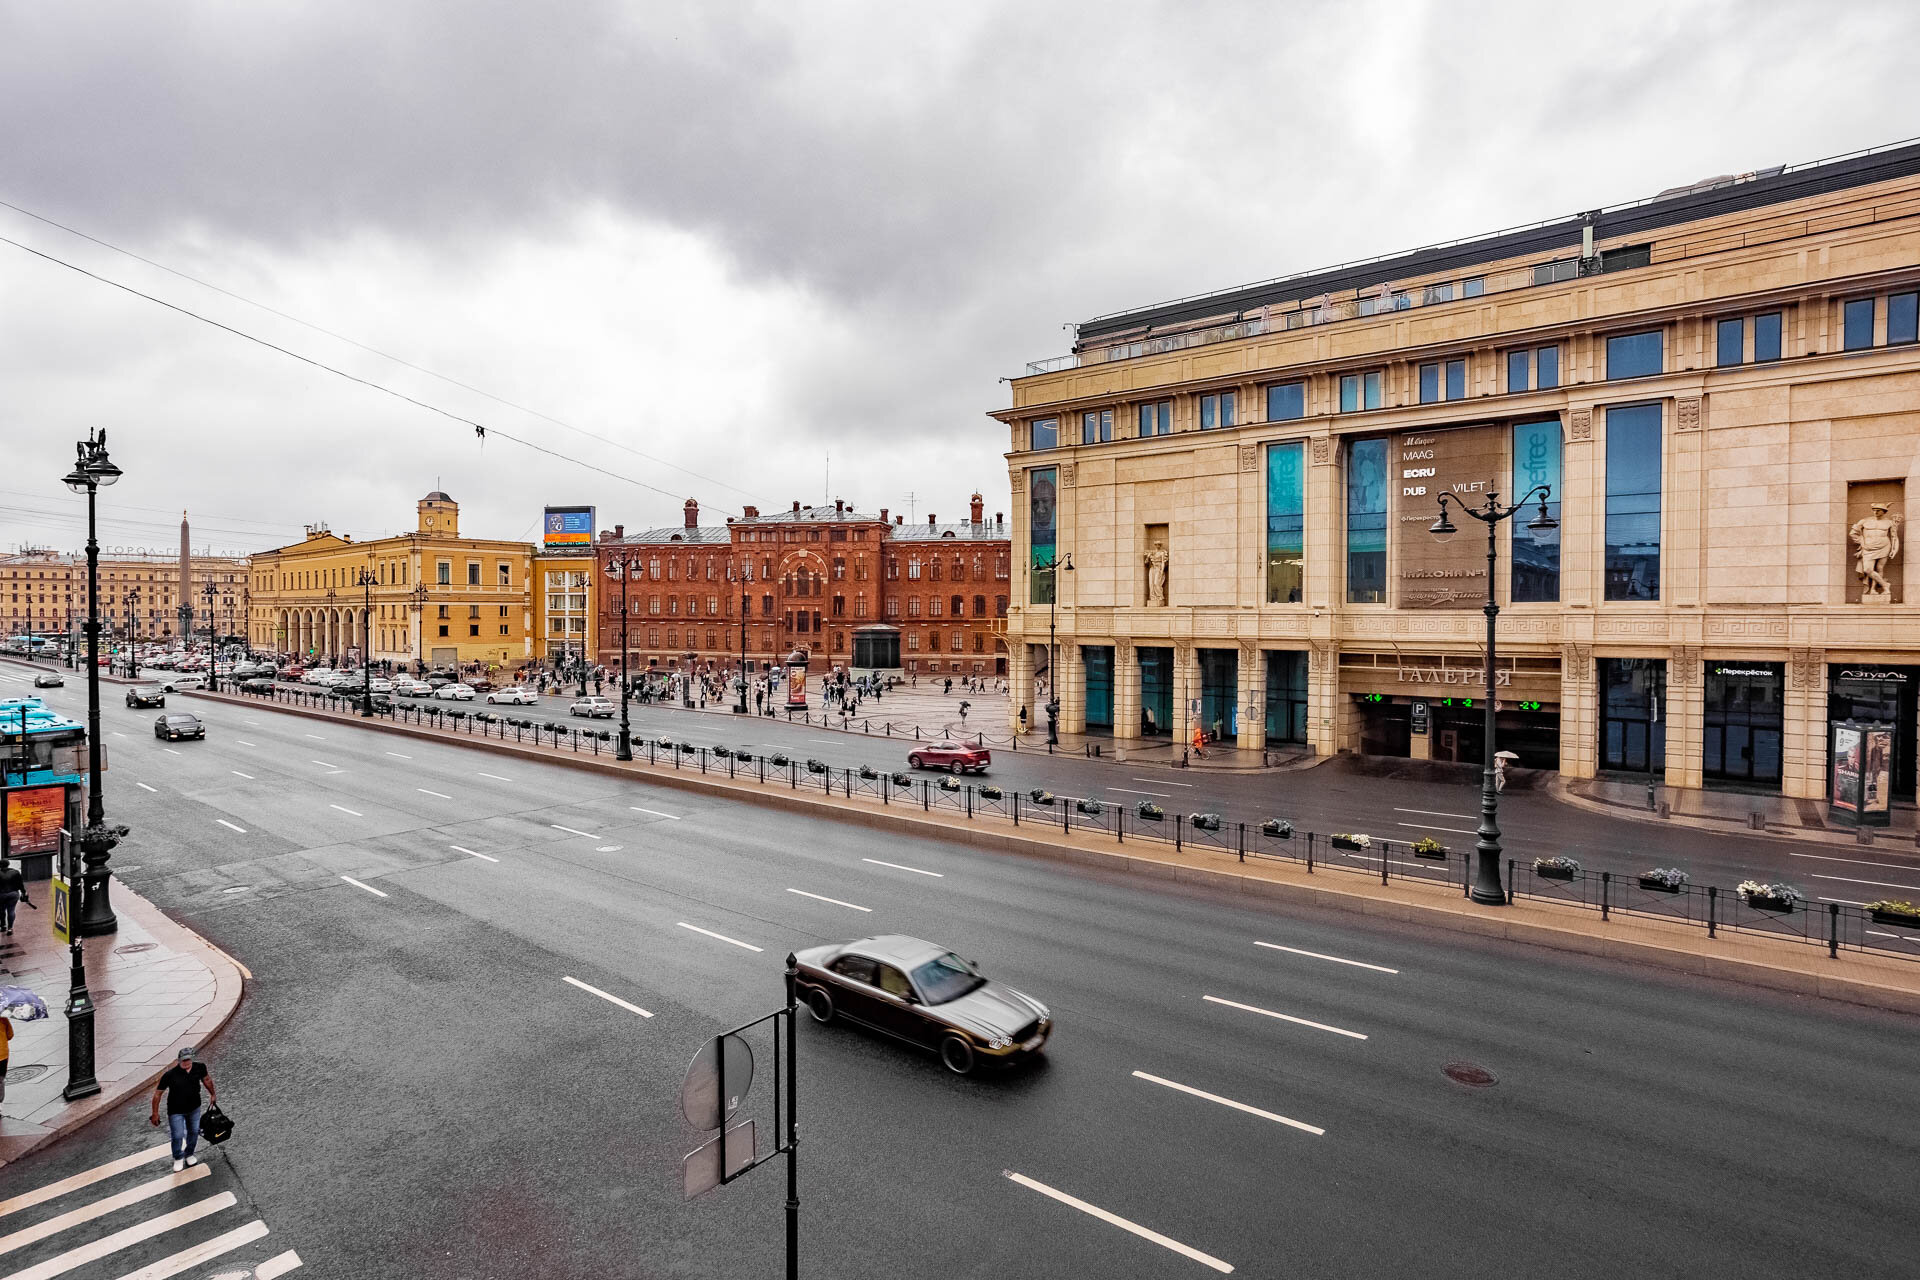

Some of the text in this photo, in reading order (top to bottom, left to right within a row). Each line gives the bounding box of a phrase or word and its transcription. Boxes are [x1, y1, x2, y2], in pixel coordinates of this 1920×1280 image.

[1403, 449, 1434, 461] MAAG
[1403, 467, 1436, 479] ECRU
[1403, 486, 1427, 496] DUB
[1452, 481, 1486, 493] VILET
[106, 545, 212, 558] ГОРОД-ГЕОЙ
[1397, 665, 1512, 686] ГАЛЕРЕЯ
